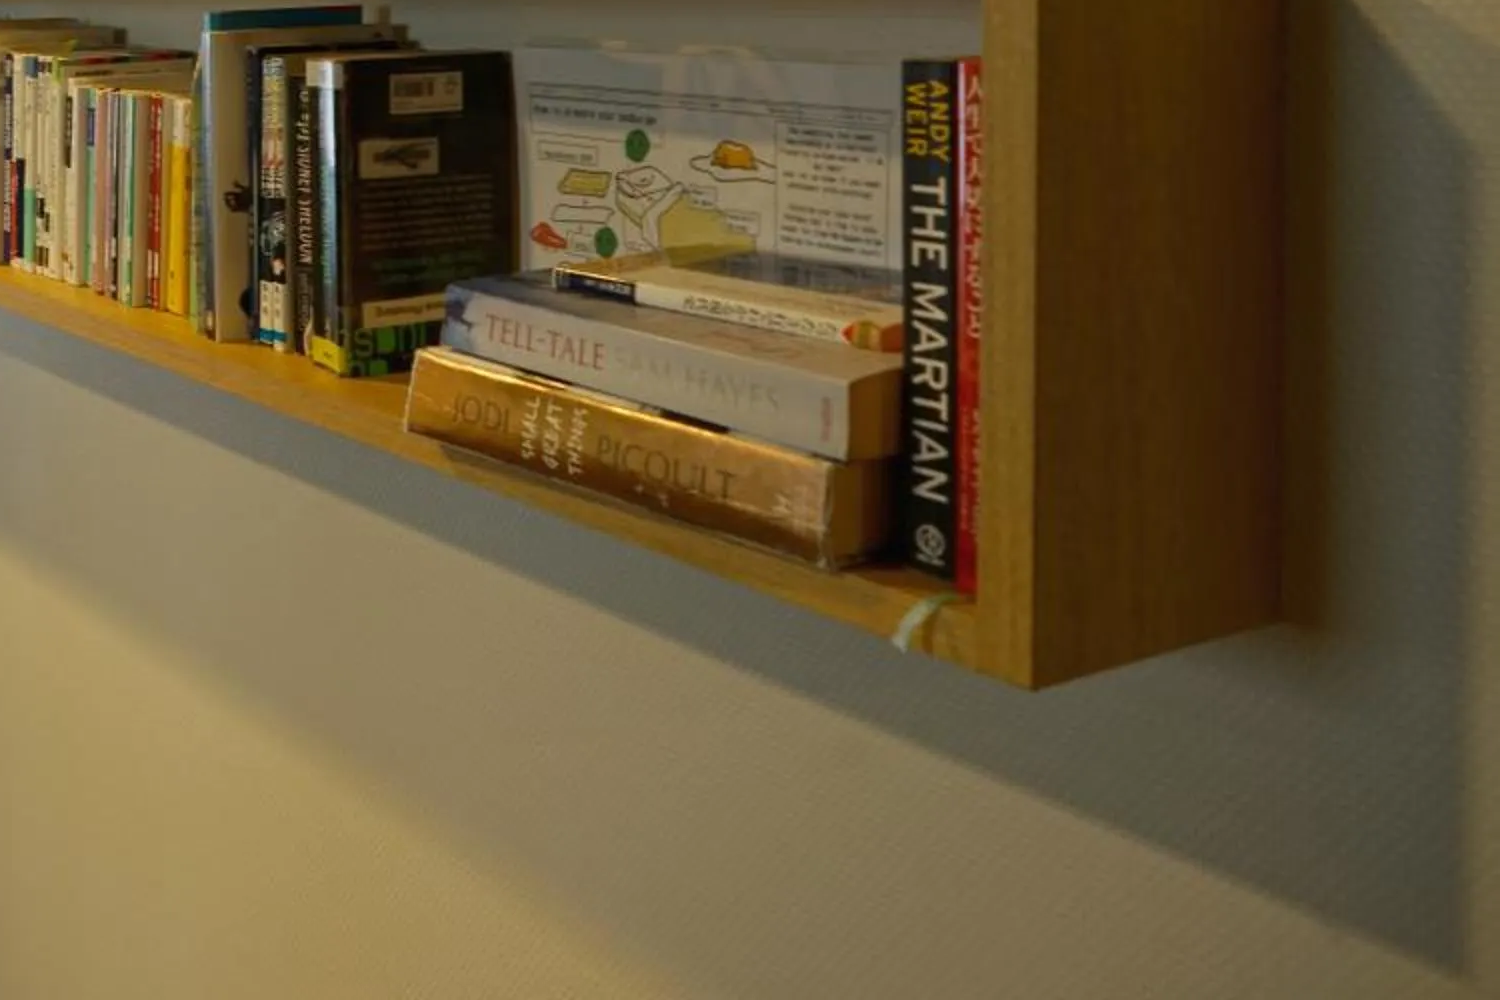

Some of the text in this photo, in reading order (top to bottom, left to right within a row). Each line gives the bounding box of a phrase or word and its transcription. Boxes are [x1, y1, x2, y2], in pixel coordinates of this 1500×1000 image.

[906, 83, 928, 156] WEIR
[929, 80, 950, 163] ANDY
[486, 312, 605, 370] TELL-TALE
[910, 176, 949, 504] THE MARTIAN
[451, 391, 737, 500] JODI PICOULT
[520, 396, 541, 460] SMALL
